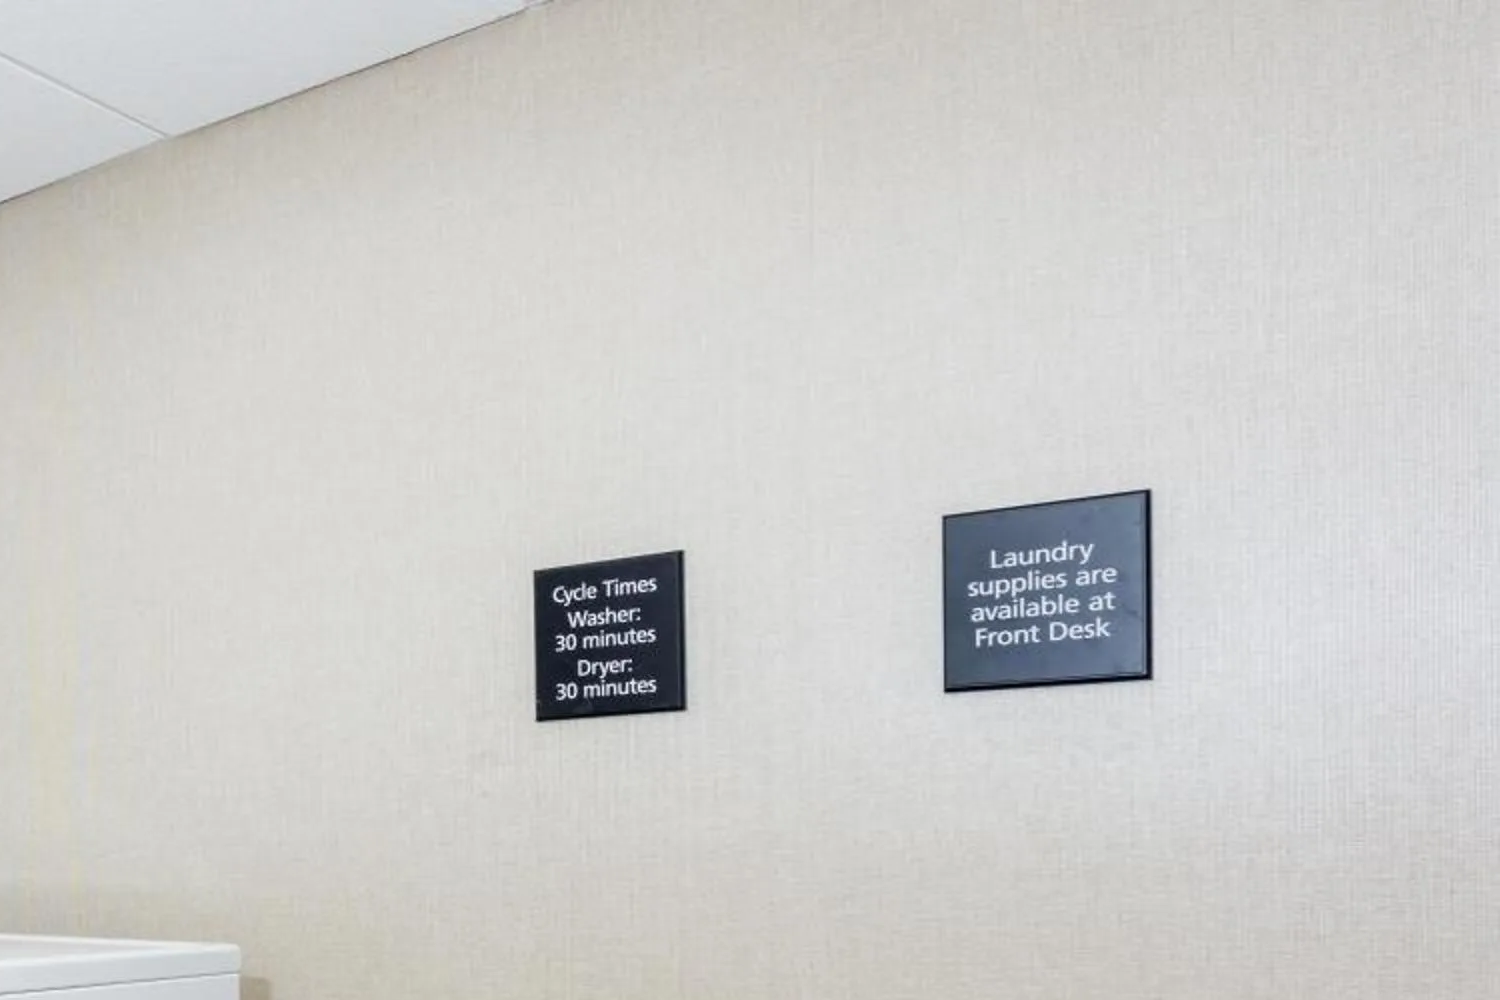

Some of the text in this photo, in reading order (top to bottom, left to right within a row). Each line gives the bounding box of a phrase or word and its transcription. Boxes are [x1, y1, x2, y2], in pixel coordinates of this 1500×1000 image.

[990, 540, 1095, 569] Laundry
[553, 578, 657, 606] Cycle Times
[967, 567, 1118, 599] supplies are
[567, 606, 641, 628] Washer:
[970, 592, 1116, 622] available at
[555, 628, 657, 652] 30 minutes
[975, 617, 1111, 648] Front Desk
[577, 659, 633, 678] Dryer:
[556, 678, 657, 701] 30 minutes
